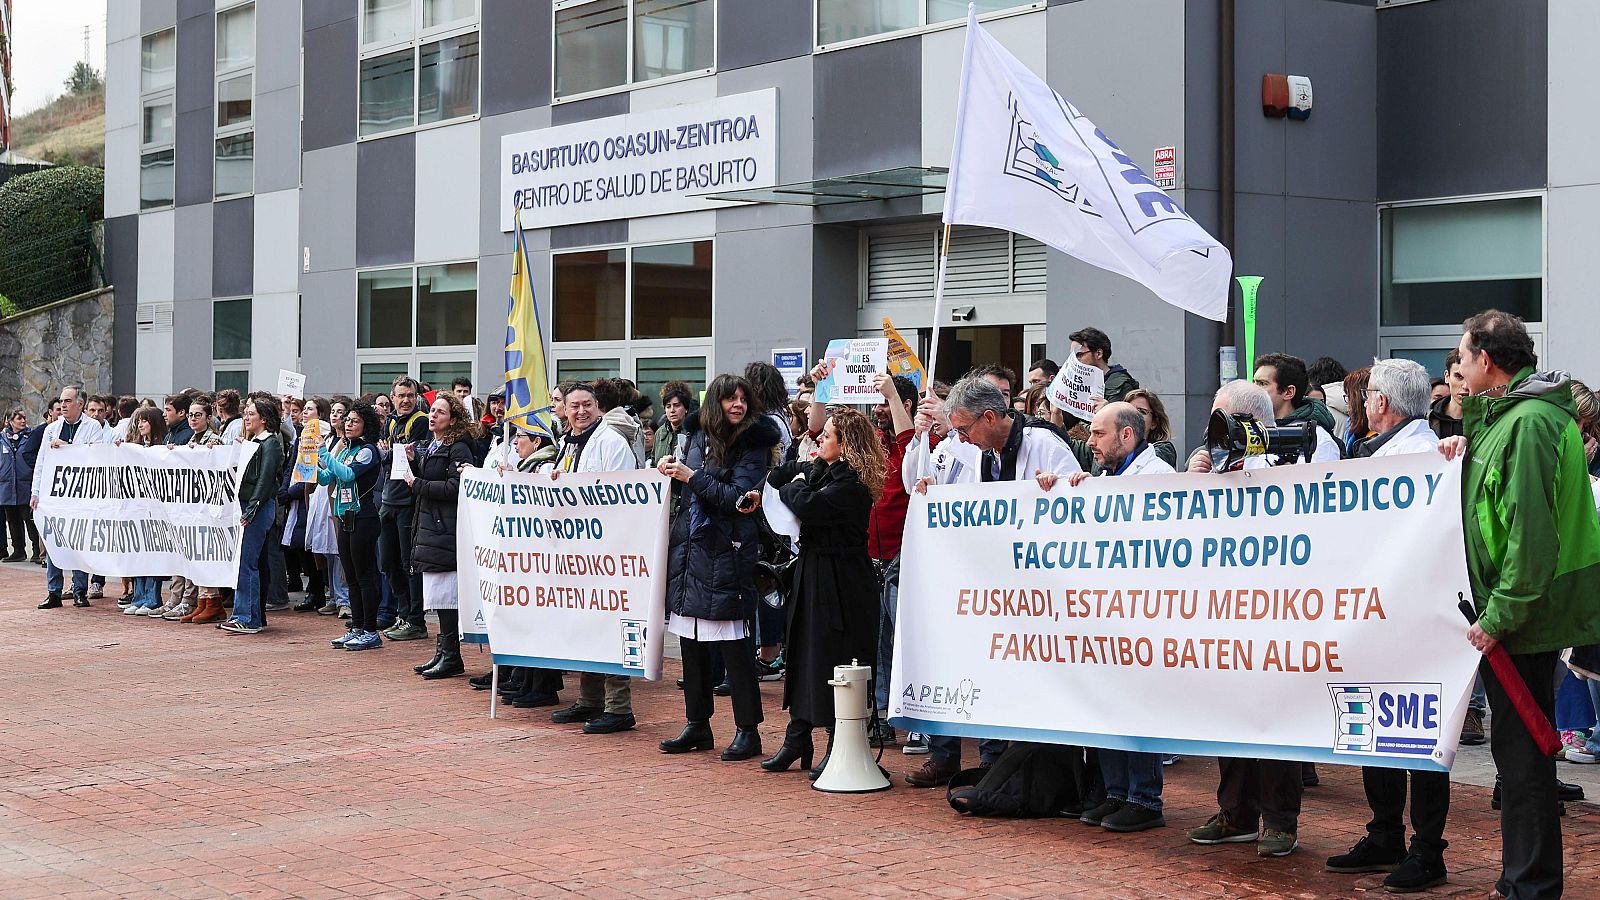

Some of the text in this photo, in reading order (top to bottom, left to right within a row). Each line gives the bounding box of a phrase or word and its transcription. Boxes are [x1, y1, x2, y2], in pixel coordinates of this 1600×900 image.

[511, 114, 759, 175] BASURTUKO OSASUN-ZENTROA
[1155, 150, 1174, 161] ABRA
[513, 156, 758, 211] CENTRO DE SALUD DE BASURTO
[846, 363, 877, 375] VOCACIÓN,
[852, 354, 870, 363] NO ES
[858, 375, 867, 384] ES
[1074, 374, 1083, 384] ES
[1069, 391, 1078, 400] ES
[511, 484, 579, 508] ESTATUTO
[578, 478, 649, 506] MÉDICO
[652, 481, 663, 505] Y
[926, 472, 1444, 530] EUSKADI, POR UN ESTATUTO MÉDICO Y
[545, 517, 603, 540] PROPIO
[1012, 533, 1312, 569] FACULTATIVO PROPIO
[555, 553, 617, 578] MEDIKO
[620, 554, 650, 578] ETA
[535, 585, 585, 610] BATEN
[589, 588, 630, 612] ALDE
[957, 586, 1387, 622] EUSKADI, ESTATUTU MEDIKO ETA
[989, 632, 1344, 673] FAKULTATIBO BATEN ALDE
[1377, 691, 1439, 730] SME
